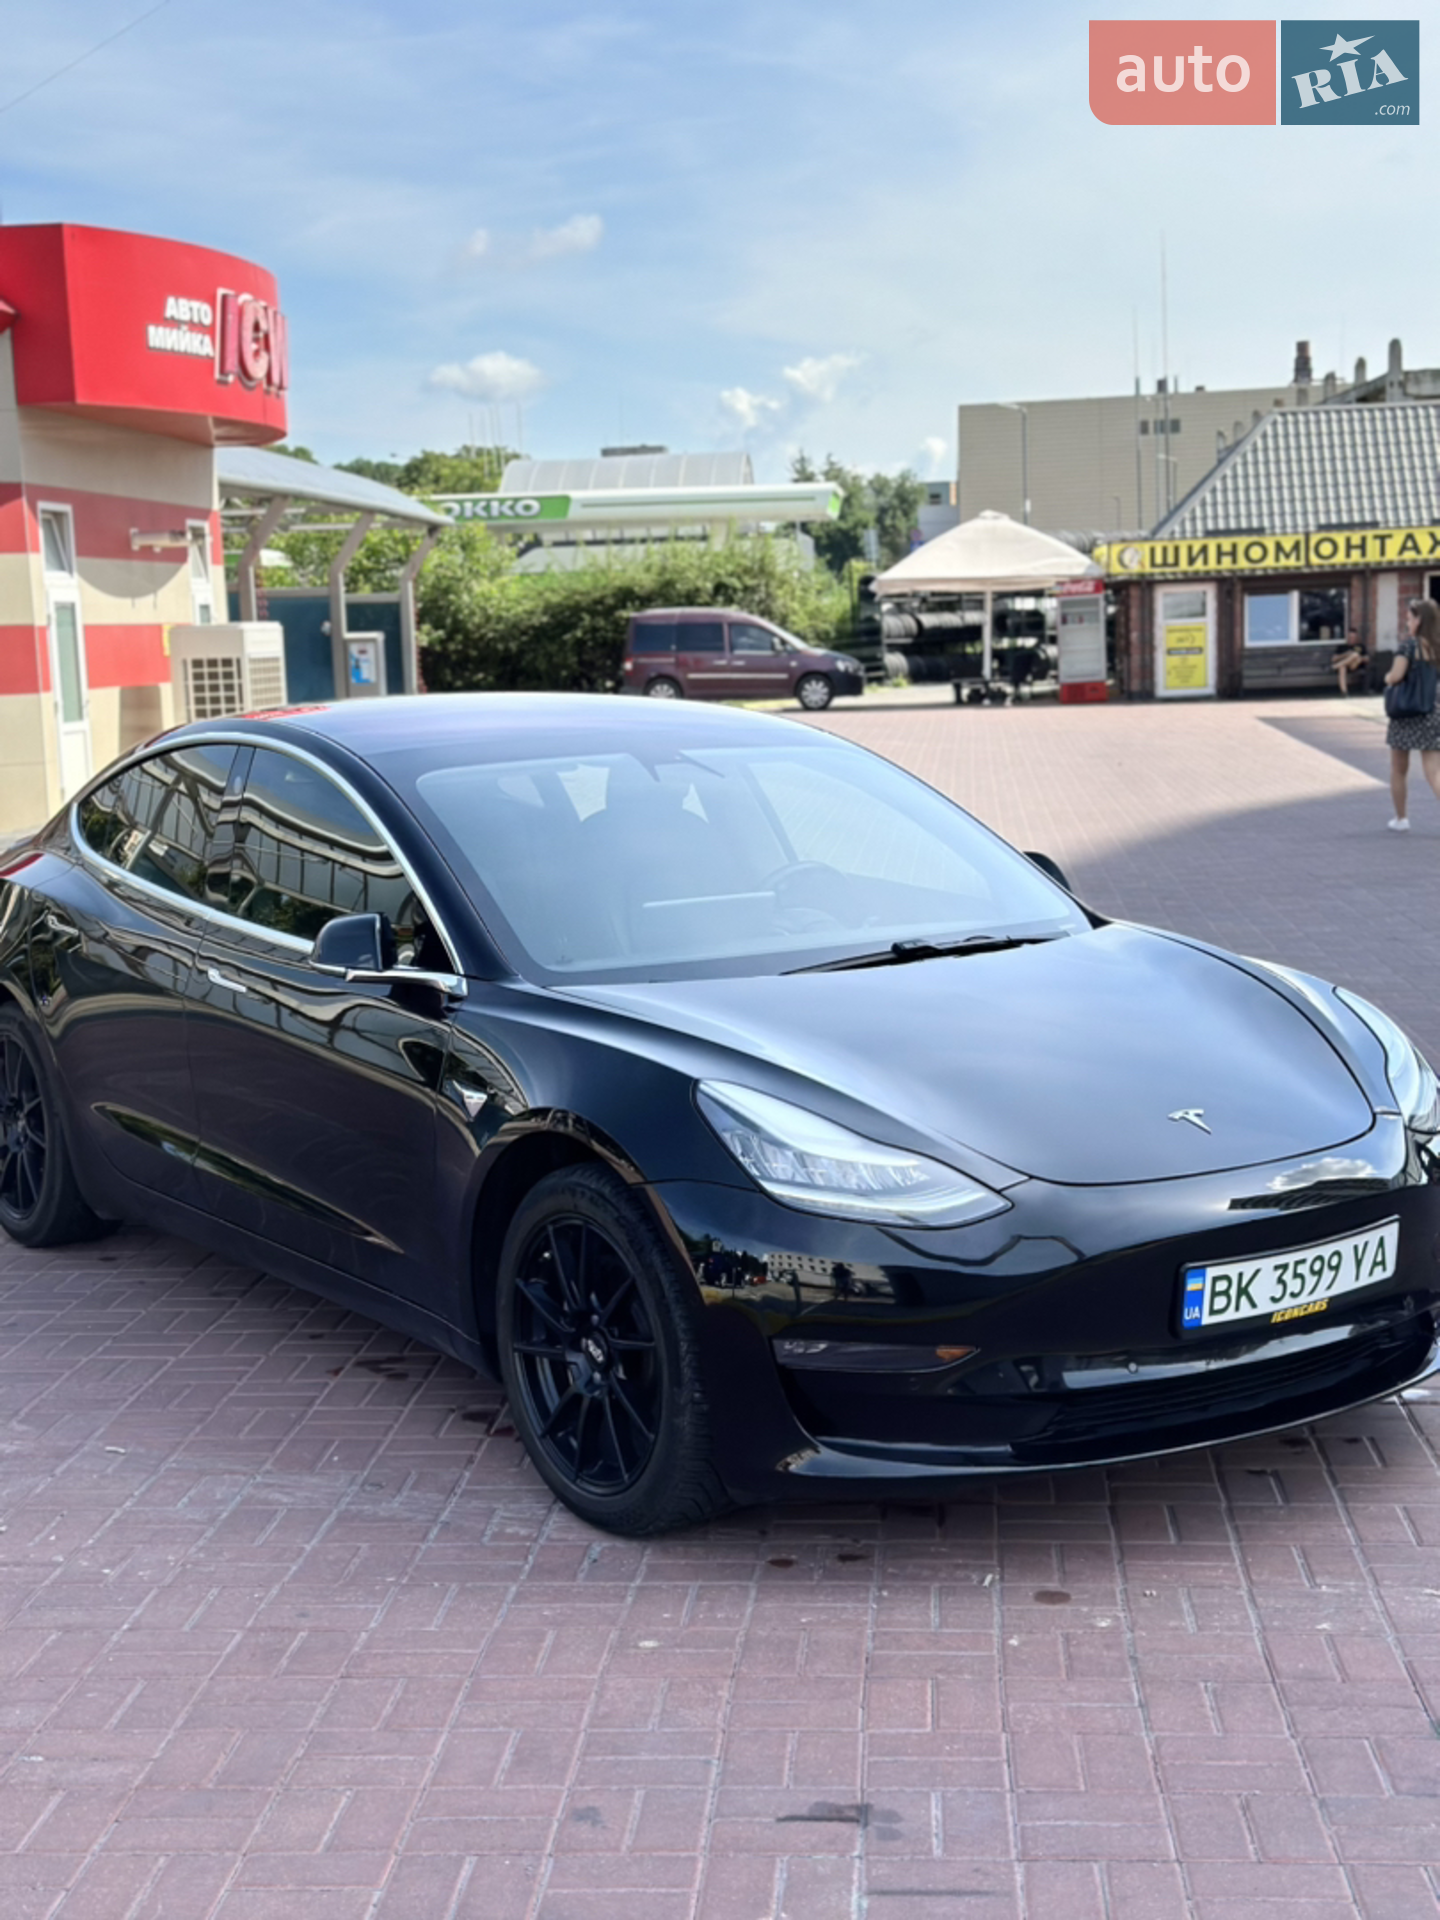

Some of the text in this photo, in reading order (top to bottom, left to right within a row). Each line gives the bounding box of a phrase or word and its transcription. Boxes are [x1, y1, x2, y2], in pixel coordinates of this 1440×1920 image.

[164, 296, 213, 327] АВТО
[146, 323, 216, 358] МИЙКА
[1208, 1235, 1388, 1317] BK 3599 YA
[1183, 1305, 1201, 1320] UA
